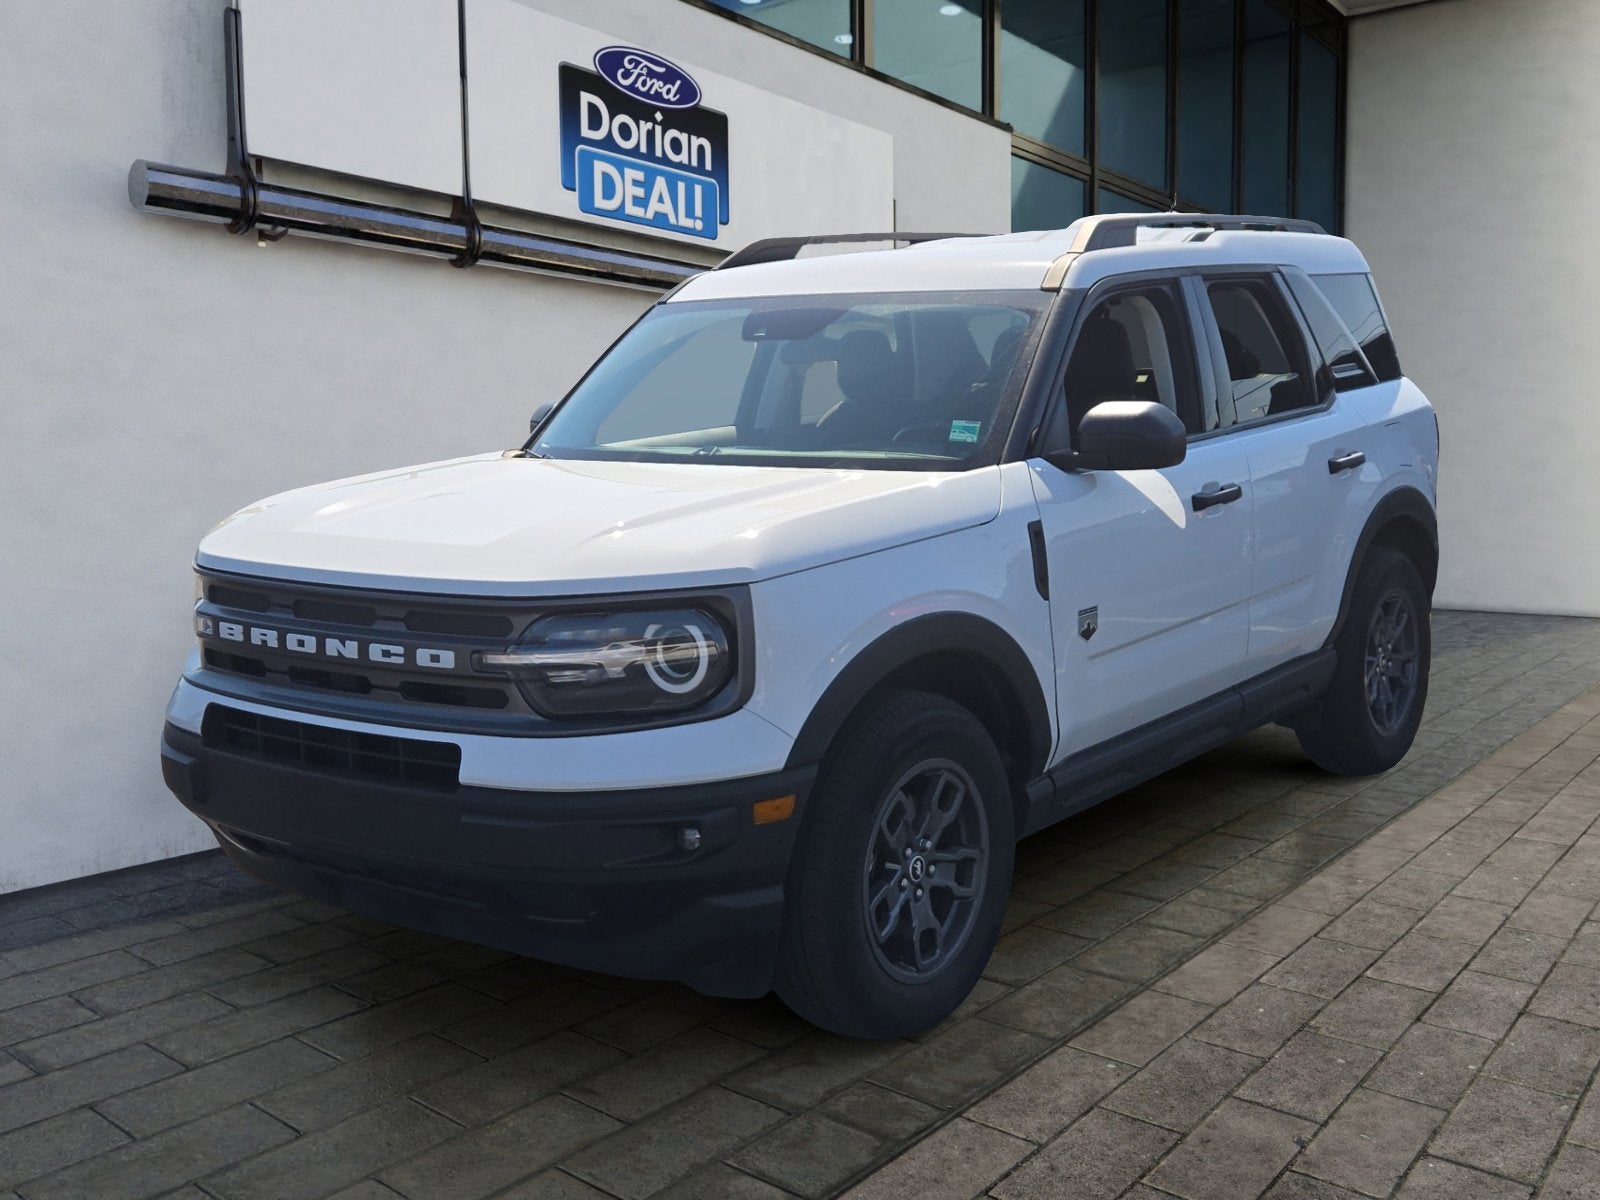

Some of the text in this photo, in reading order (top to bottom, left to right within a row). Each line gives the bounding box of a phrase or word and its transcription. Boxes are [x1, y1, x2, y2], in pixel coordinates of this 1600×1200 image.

[617, 55, 681, 102] Ford
[580, 91, 712, 171] Dorian
[593, 160, 704, 231] DEAL!
[218, 621, 455, 669] BRONCO
